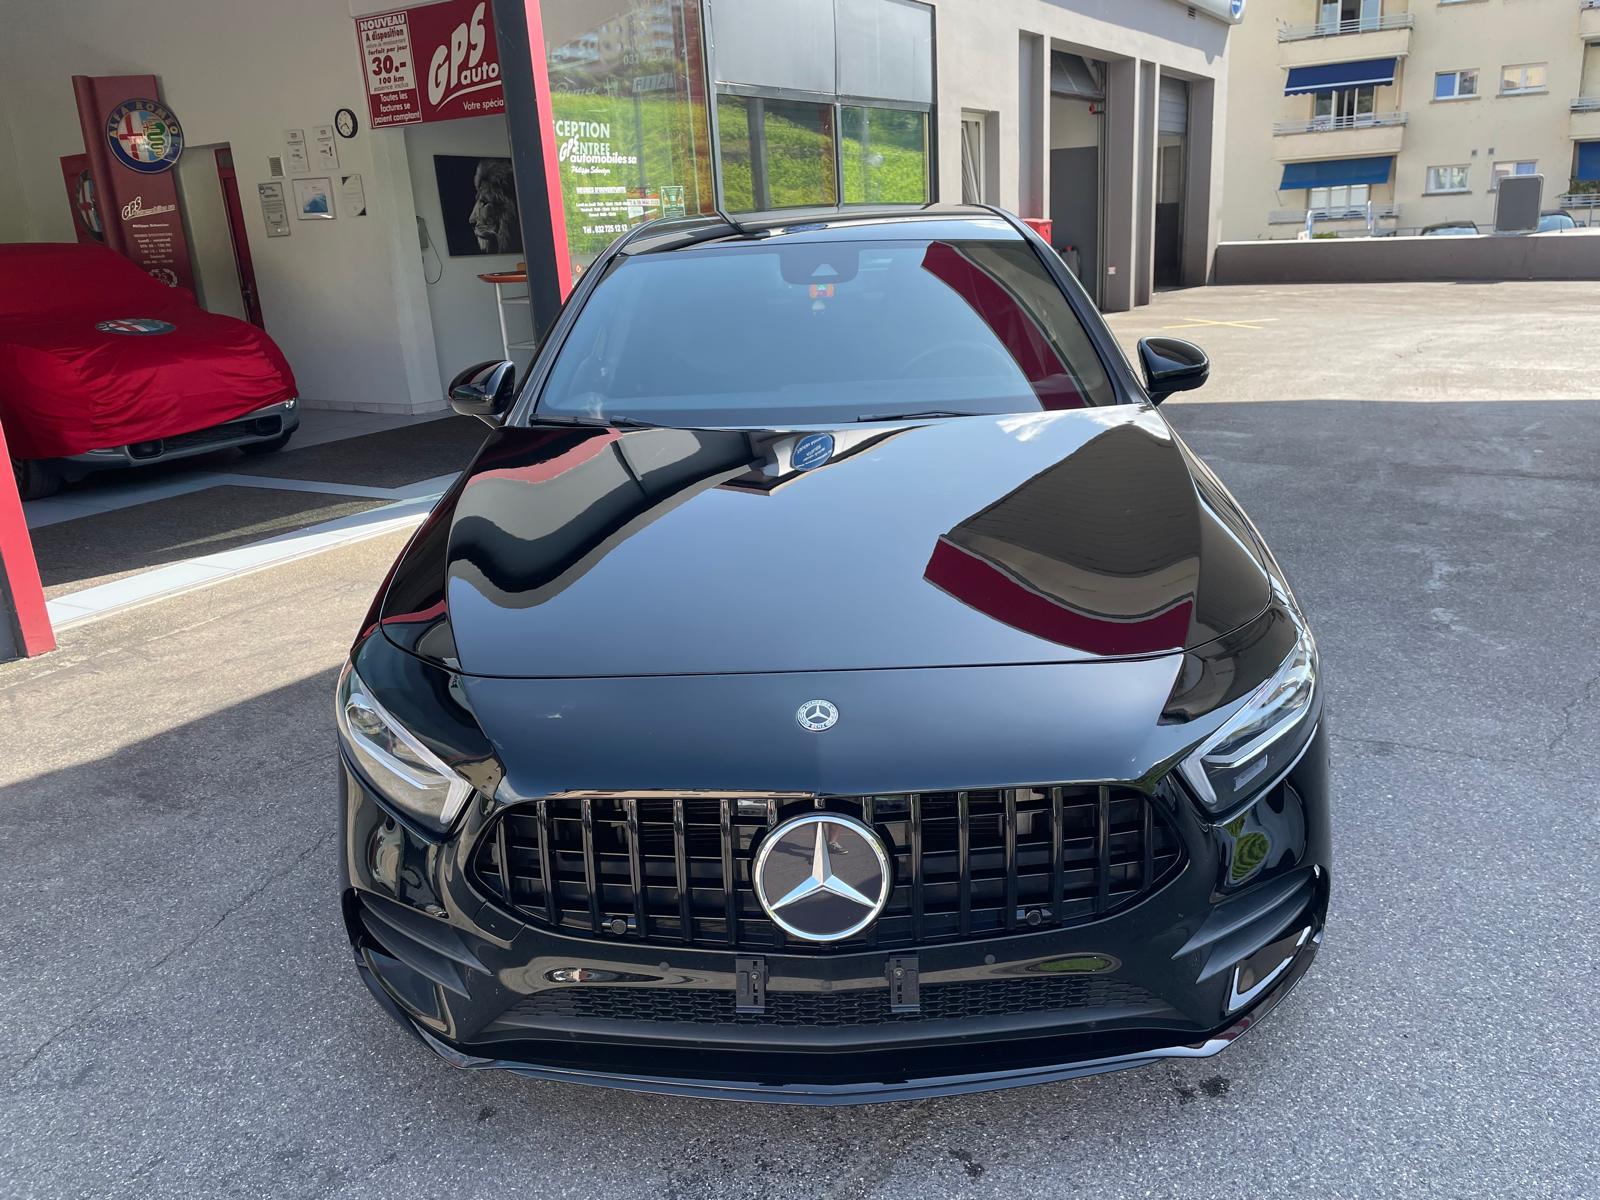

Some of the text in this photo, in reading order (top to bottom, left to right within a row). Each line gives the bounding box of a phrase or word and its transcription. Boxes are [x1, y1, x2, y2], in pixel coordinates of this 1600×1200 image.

[360, 14, 405, 31] NOUVEAU
[372, 27, 404, 41] disposition
[428, 2, 486, 105] GPS
[461, 62, 499, 85] auto
[379, 77, 392, 85] 100
[380, 91, 408, 102] Toutes les
[380, 102, 403, 113] factures
[463, 101, 481, 111] Votre
[109, 101, 179, 137] ALFA ROMEO
[374, 111, 420, 126] paient comptant
[570, 152, 638, 164] automobiles sa
[122, 196, 142, 220] GPS
